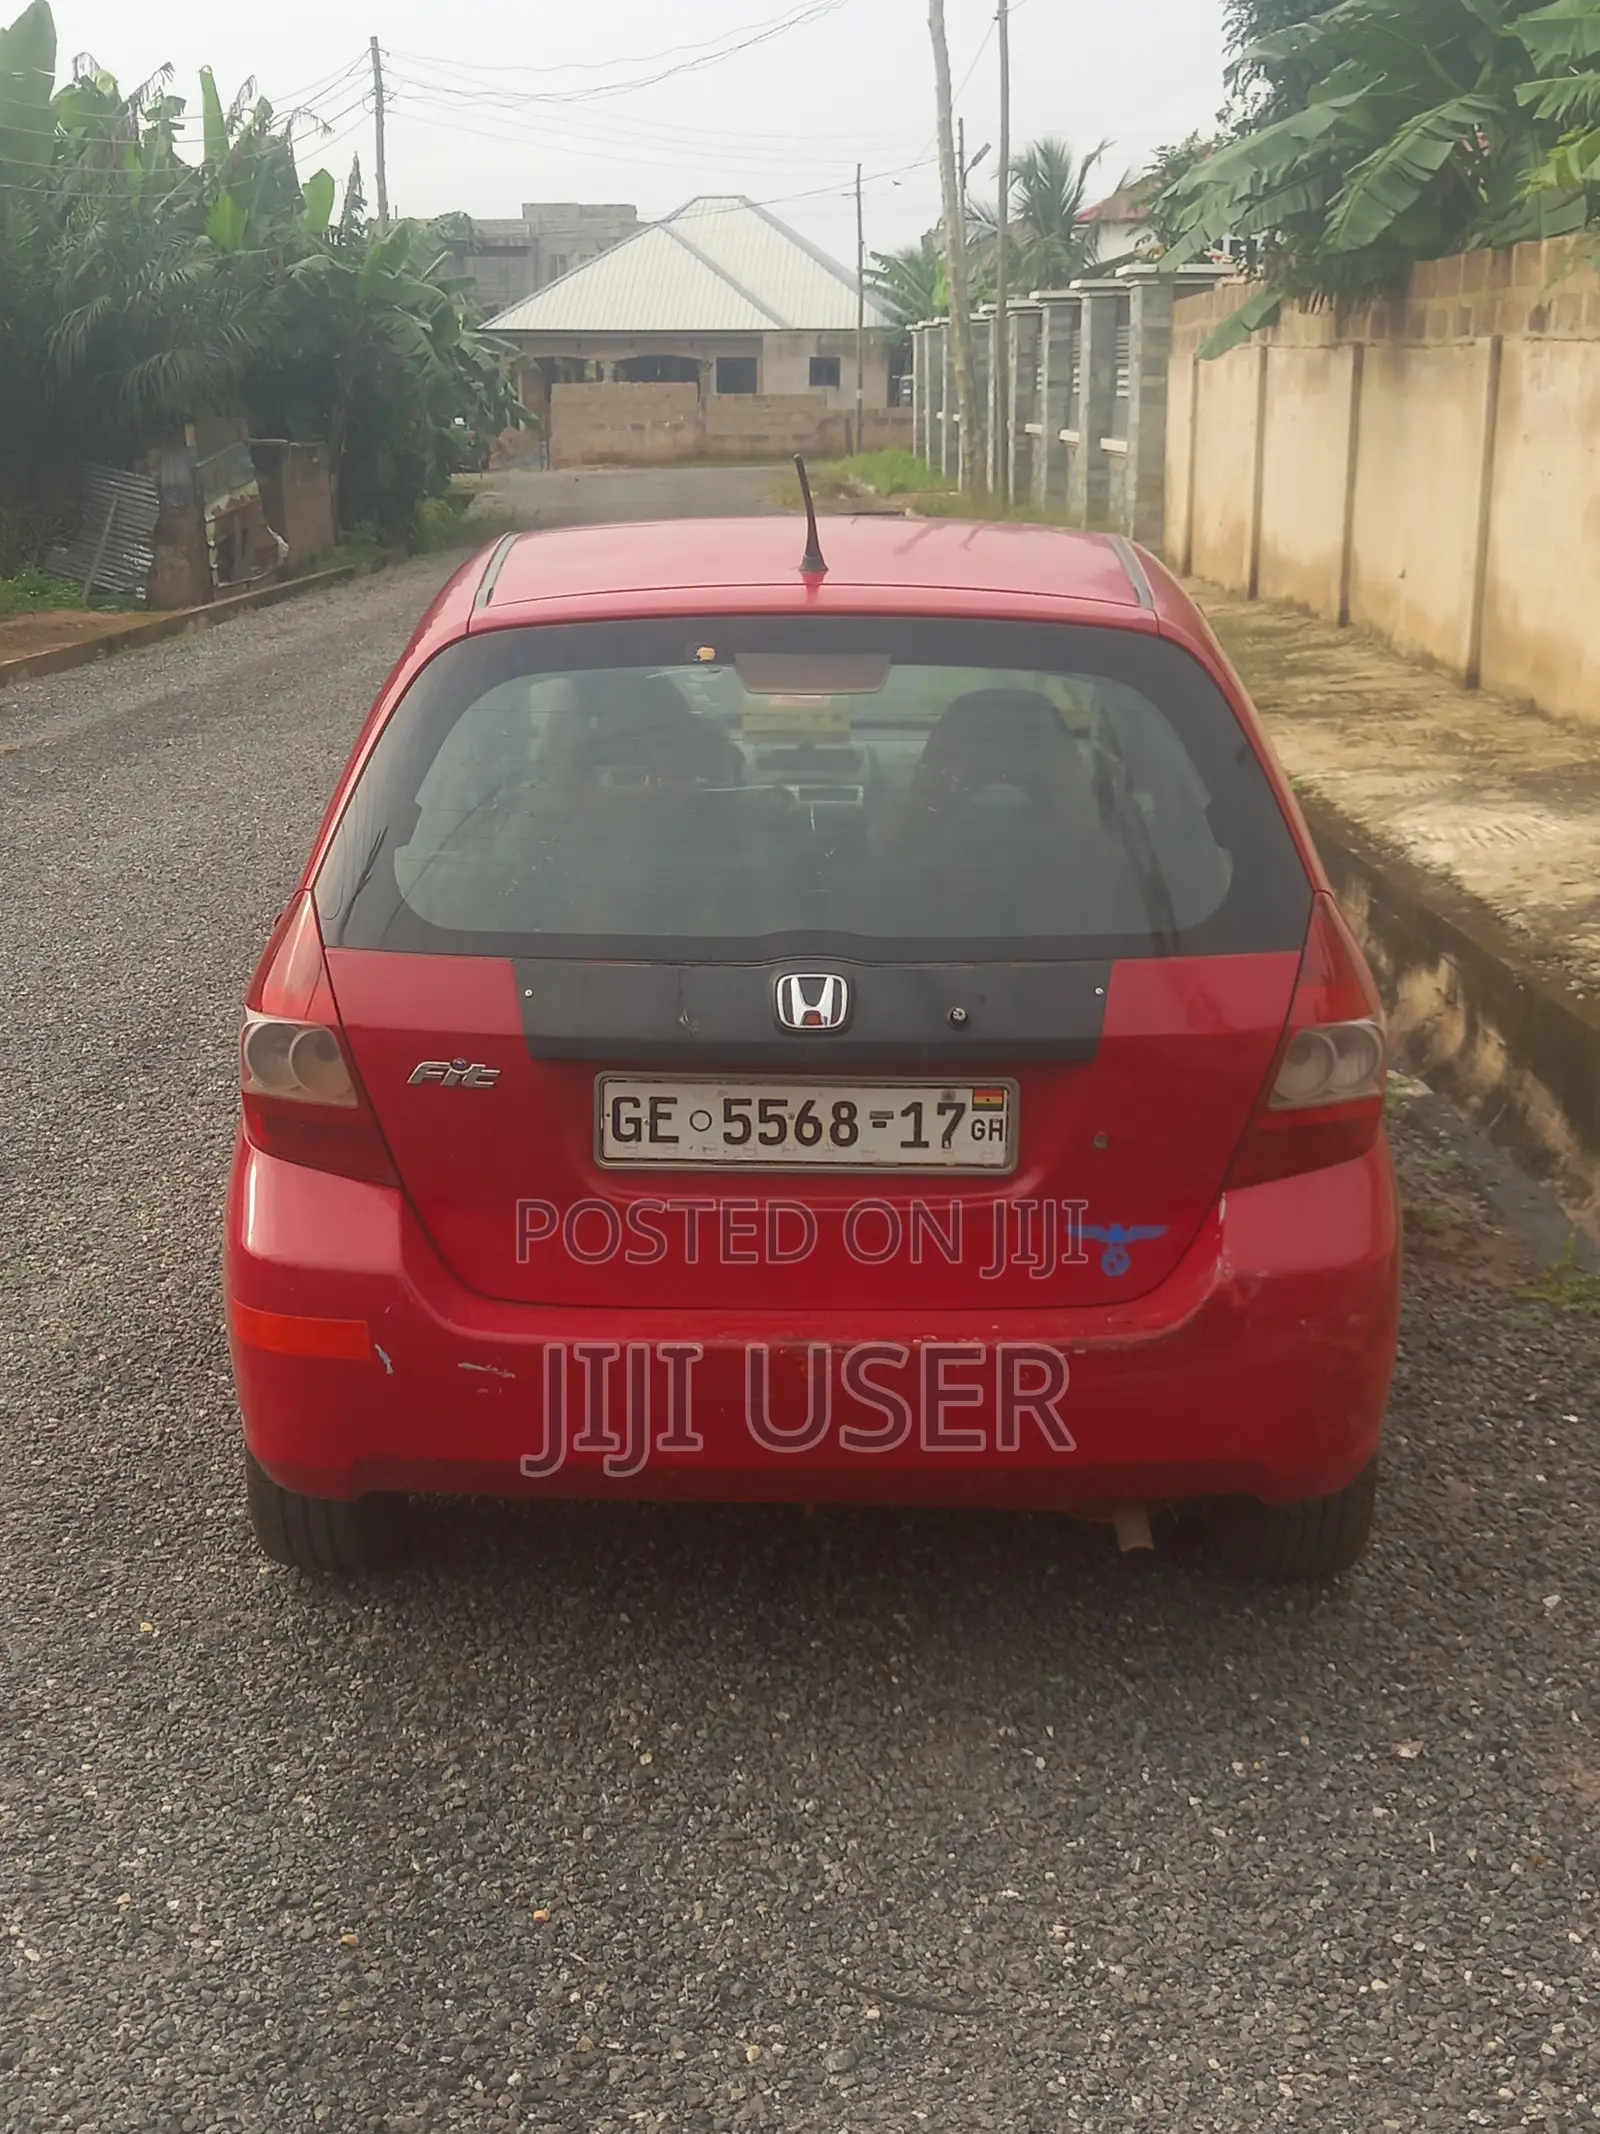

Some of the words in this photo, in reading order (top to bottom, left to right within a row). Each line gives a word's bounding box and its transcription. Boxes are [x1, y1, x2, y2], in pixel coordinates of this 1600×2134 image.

[611, 1096, 679, 1144] GE
[722, 1097, 966, 1150] 5568-17
[970, 1117, 1004, 1142] GH
